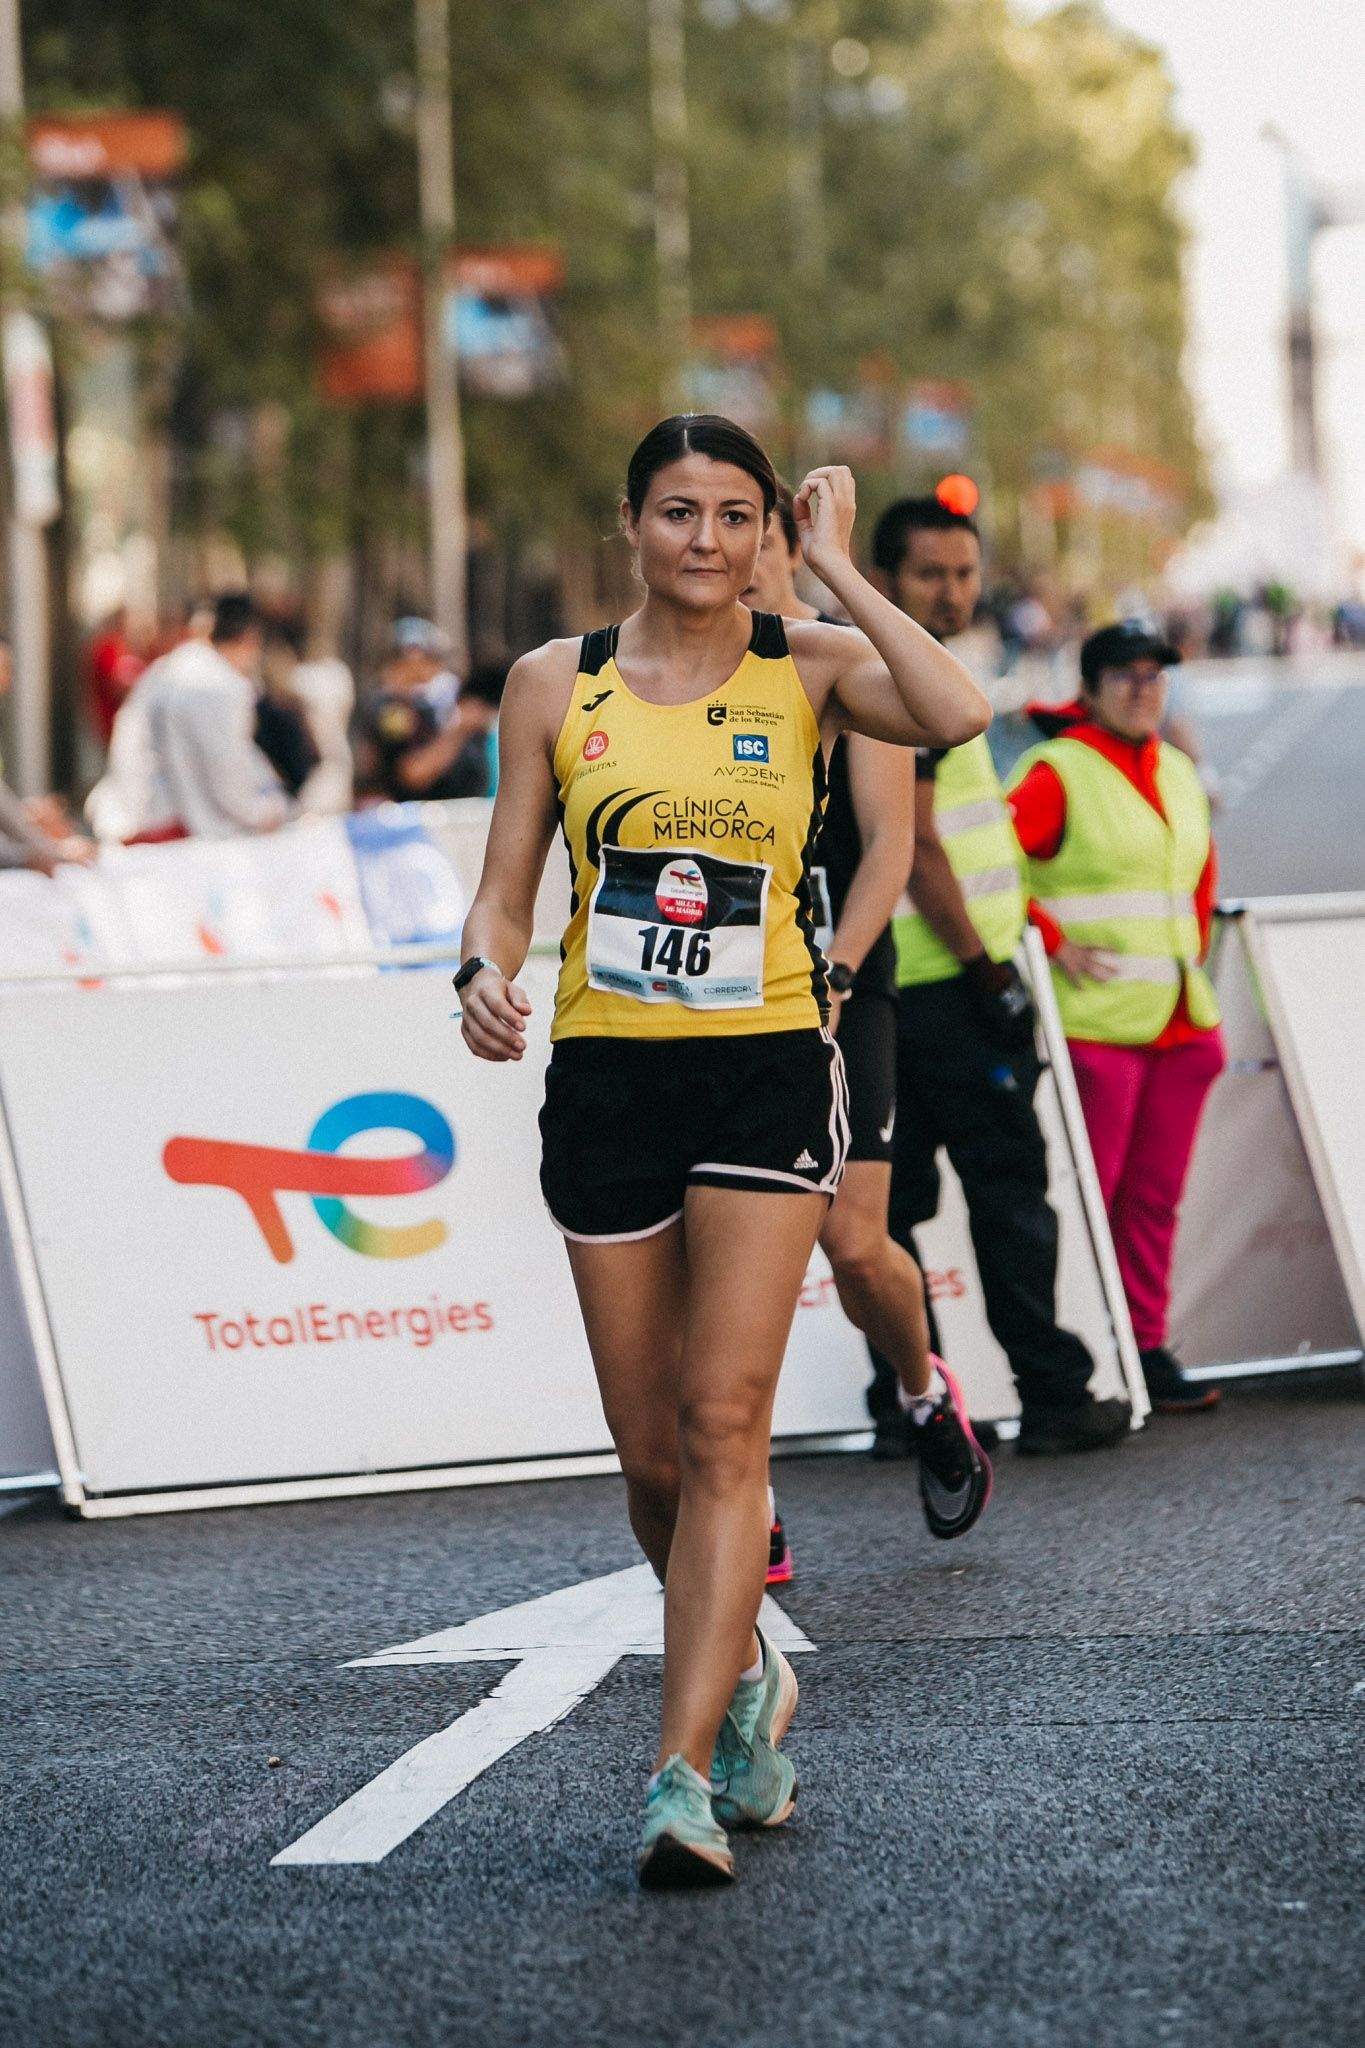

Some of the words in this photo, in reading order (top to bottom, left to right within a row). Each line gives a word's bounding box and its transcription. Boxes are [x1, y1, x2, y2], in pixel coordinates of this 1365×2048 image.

[754, 717, 778, 726] Reyes
[737, 740, 765, 756] ISC
[653, 796, 749, 819] CLÍNICA
[653, 818, 776, 846] MENORCA
[638, 925, 711, 977] 146
[193, 1292, 494, 1353] TotalEnergies
